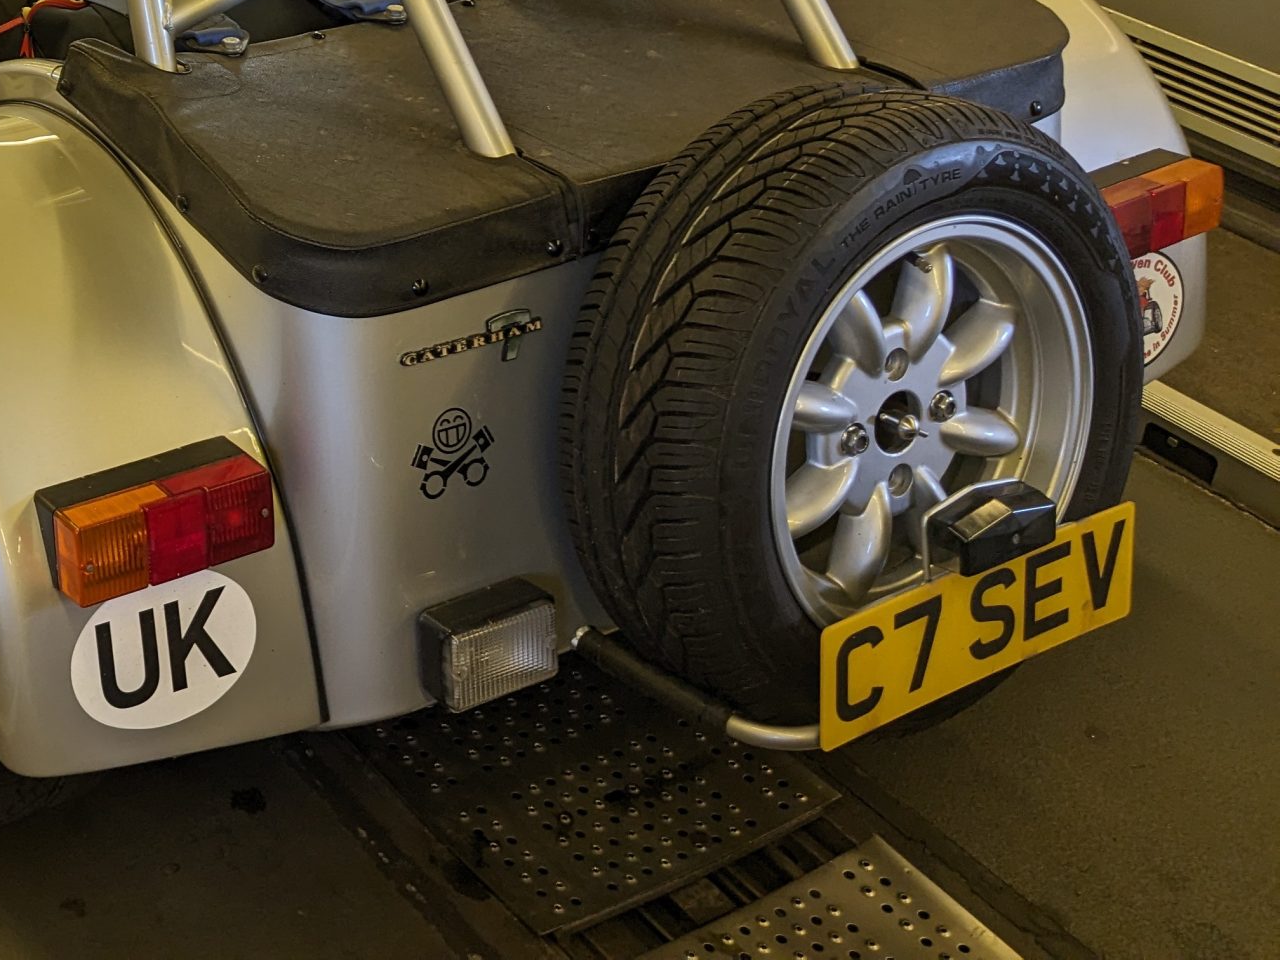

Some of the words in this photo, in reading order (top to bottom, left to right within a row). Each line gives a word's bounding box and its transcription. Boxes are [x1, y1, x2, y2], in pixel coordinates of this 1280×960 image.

[840, 218, 870, 248] THE
[874, 189, 913, 220] RAIN
[920, 168, 962, 190] TYRE
[1154, 260, 1175, 287] Club
[402, 318, 542, 366] CATERHAM
[1160, 294, 1179, 341] Summer
[95, 585, 237, 709] UK
[836, 594, 942, 722] C7
[969, 519, 1126, 660] SEV
